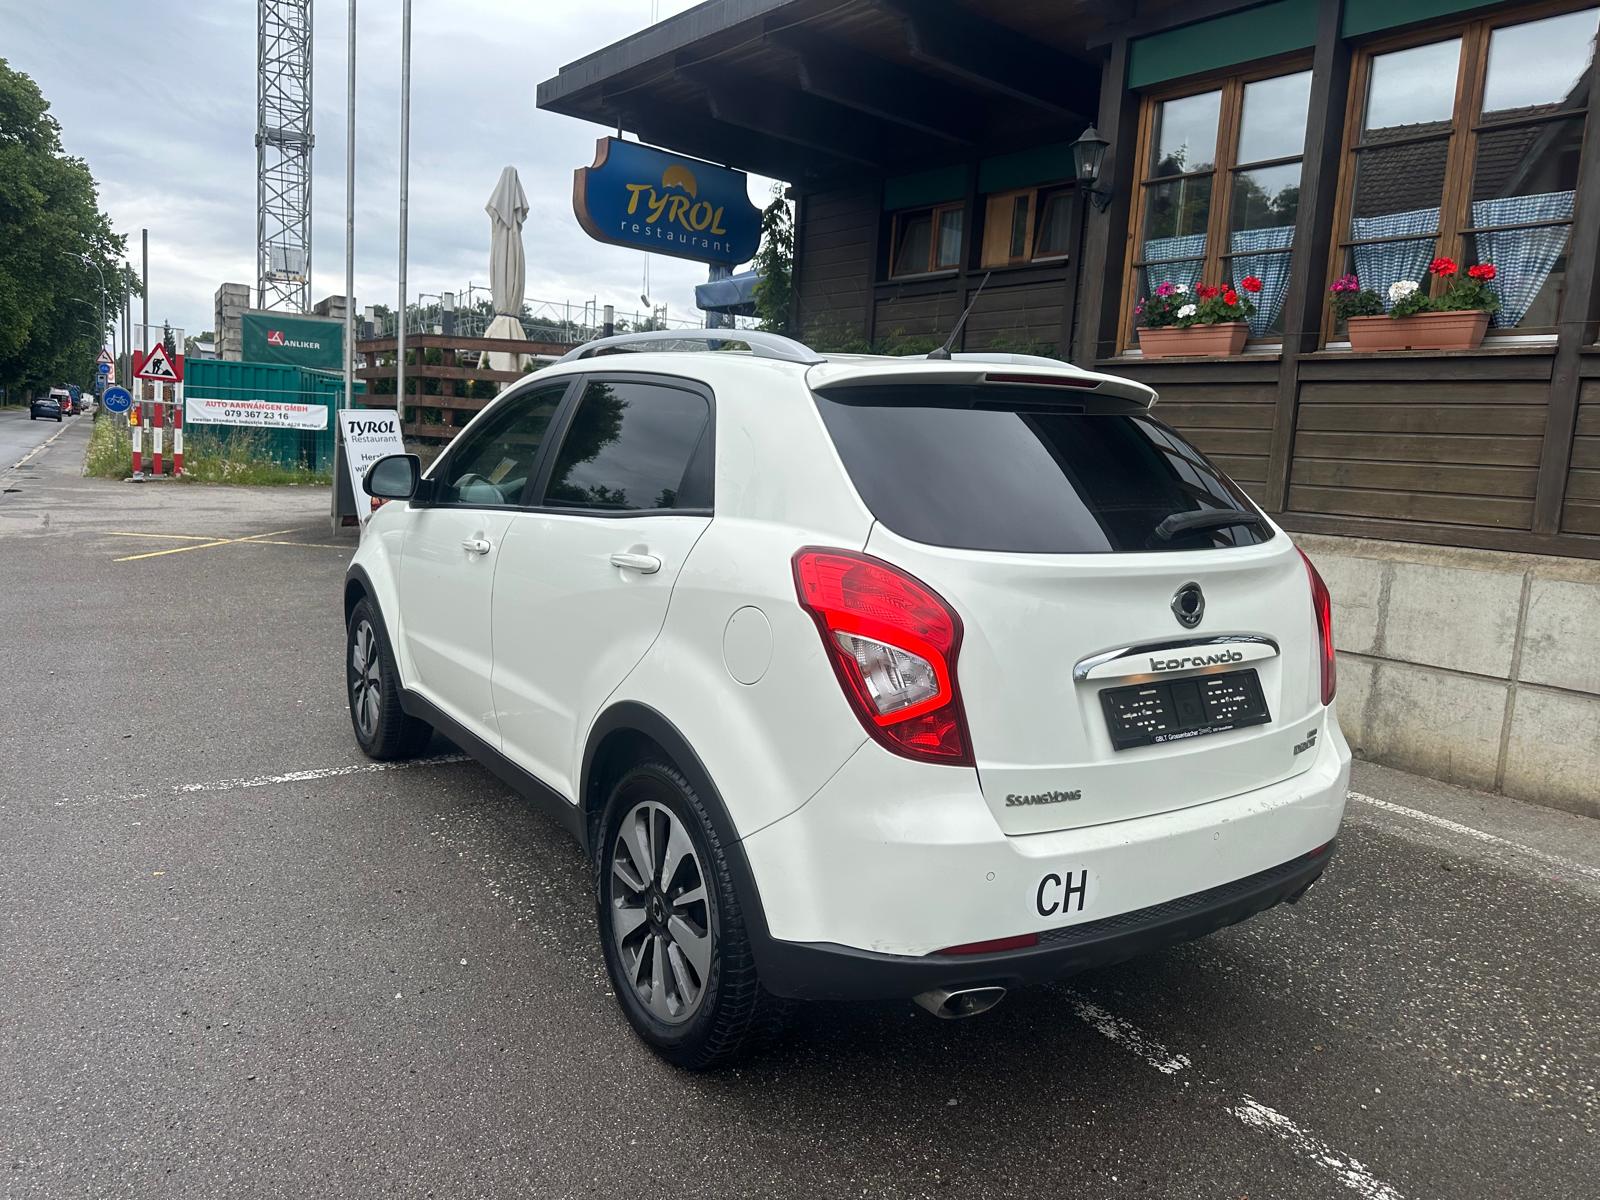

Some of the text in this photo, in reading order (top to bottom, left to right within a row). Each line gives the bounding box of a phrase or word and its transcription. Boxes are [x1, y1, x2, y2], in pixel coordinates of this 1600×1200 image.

[626, 184, 726, 235] TYROL
[621, 220, 731, 252] restaurant
[284, 340, 320, 349] ANLIKER
[205, 400, 228, 408] AUTO
[284, 403, 308, 412] GMBH
[224, 409, 289, 420] 079 367 23 16
[348, 421, 395, 436] TYROL
[352, 435, 397, 443] Restaurant
[1149, 649, 1243, 671] korando
[1036, 869, 1088, 916] CH
